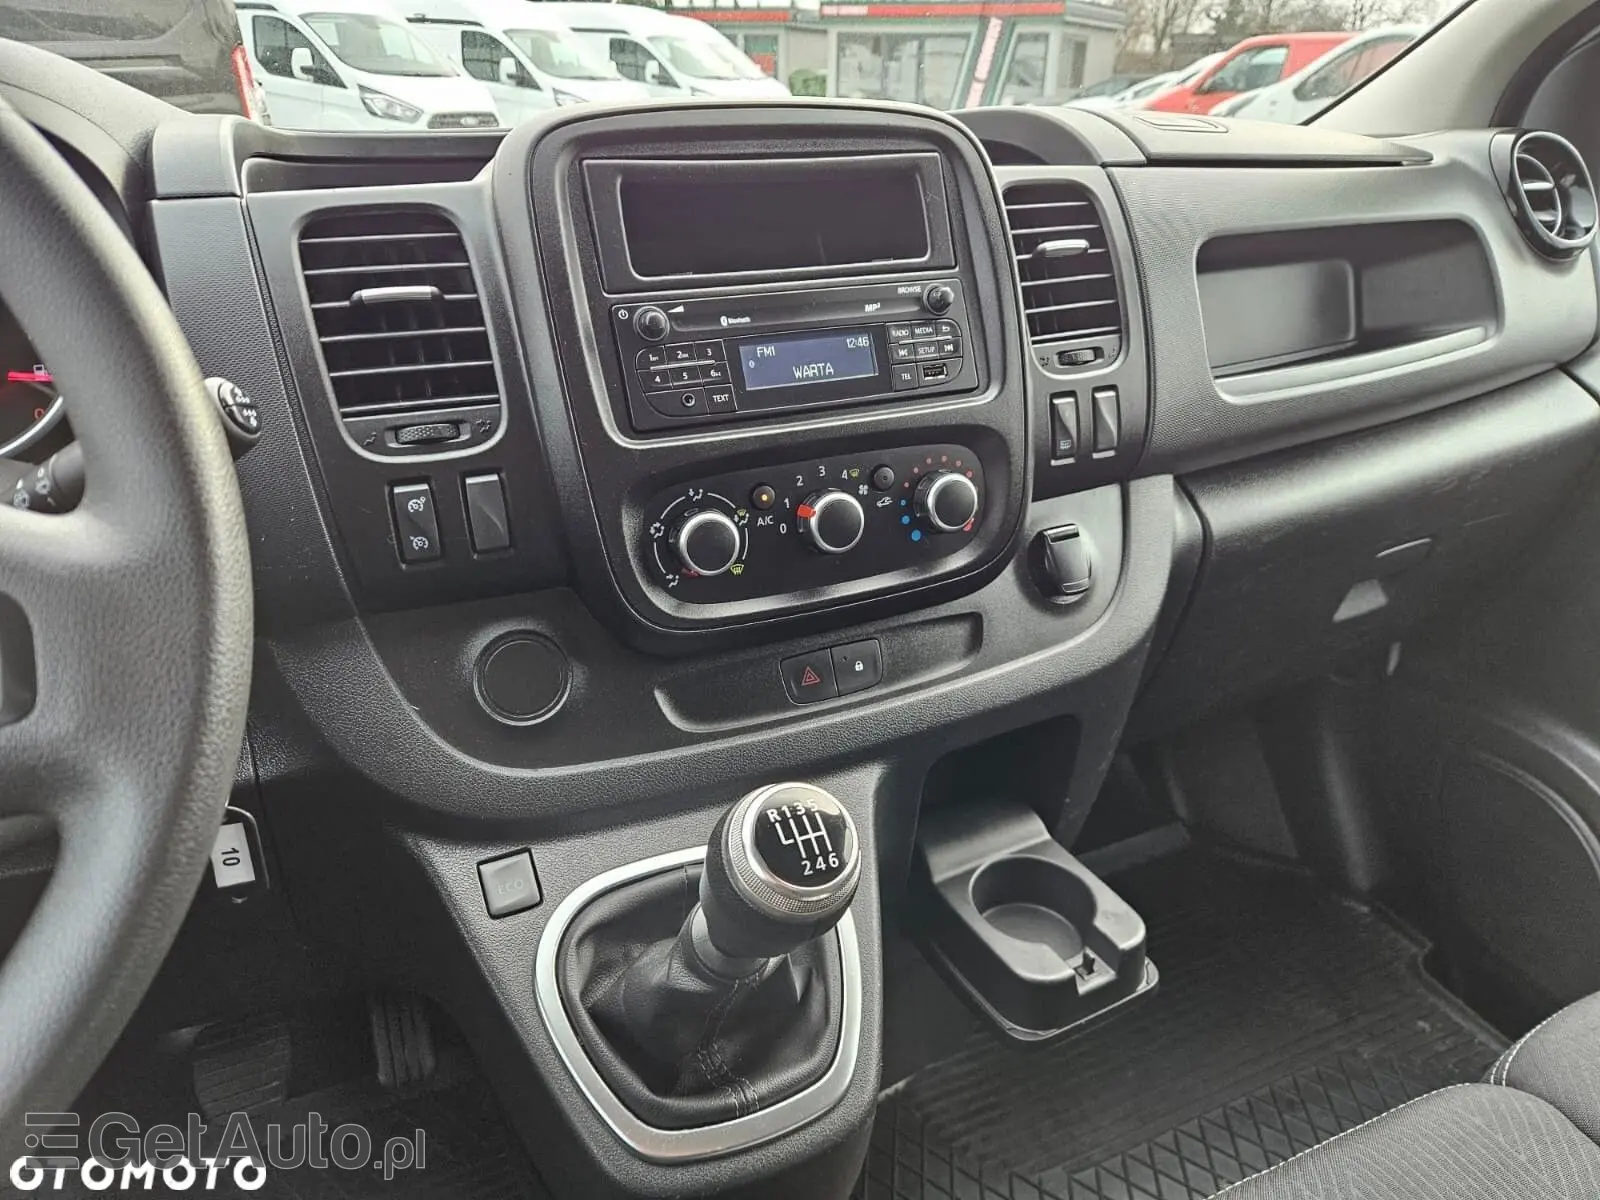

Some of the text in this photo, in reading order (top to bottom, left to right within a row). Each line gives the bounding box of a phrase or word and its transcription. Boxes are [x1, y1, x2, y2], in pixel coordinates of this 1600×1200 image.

[897, 286, 921, 294] BROWSE
[914, 327, 933, 335] MEDIA
[846, 336, 870, 349] 12:46
[706, 348, 712, 356] 3
[918, 346, 935, 354] SETUP
[792, 362, 834, 379] WARTA
[655, 375, 661, 383] 4
[682, 372, 689, 380] 5
[712, 394, 729, 402] TEXT
[819, 466, 826, 476] 3
[842, 470, 848, 480] 4
[796, 475, 804, 487] 2
[784, 498, 790, 508] 1
[757, 515, 774, 526] A/C
[780, 523, 787, 533] 0
[766, 808, 781, 822] R
[781, 805, 791, 817] 1
[794, 803, 805, 814] 3
[221, 847, 240, 866] 10
[801, 852, 839, 875] 2 4 6
